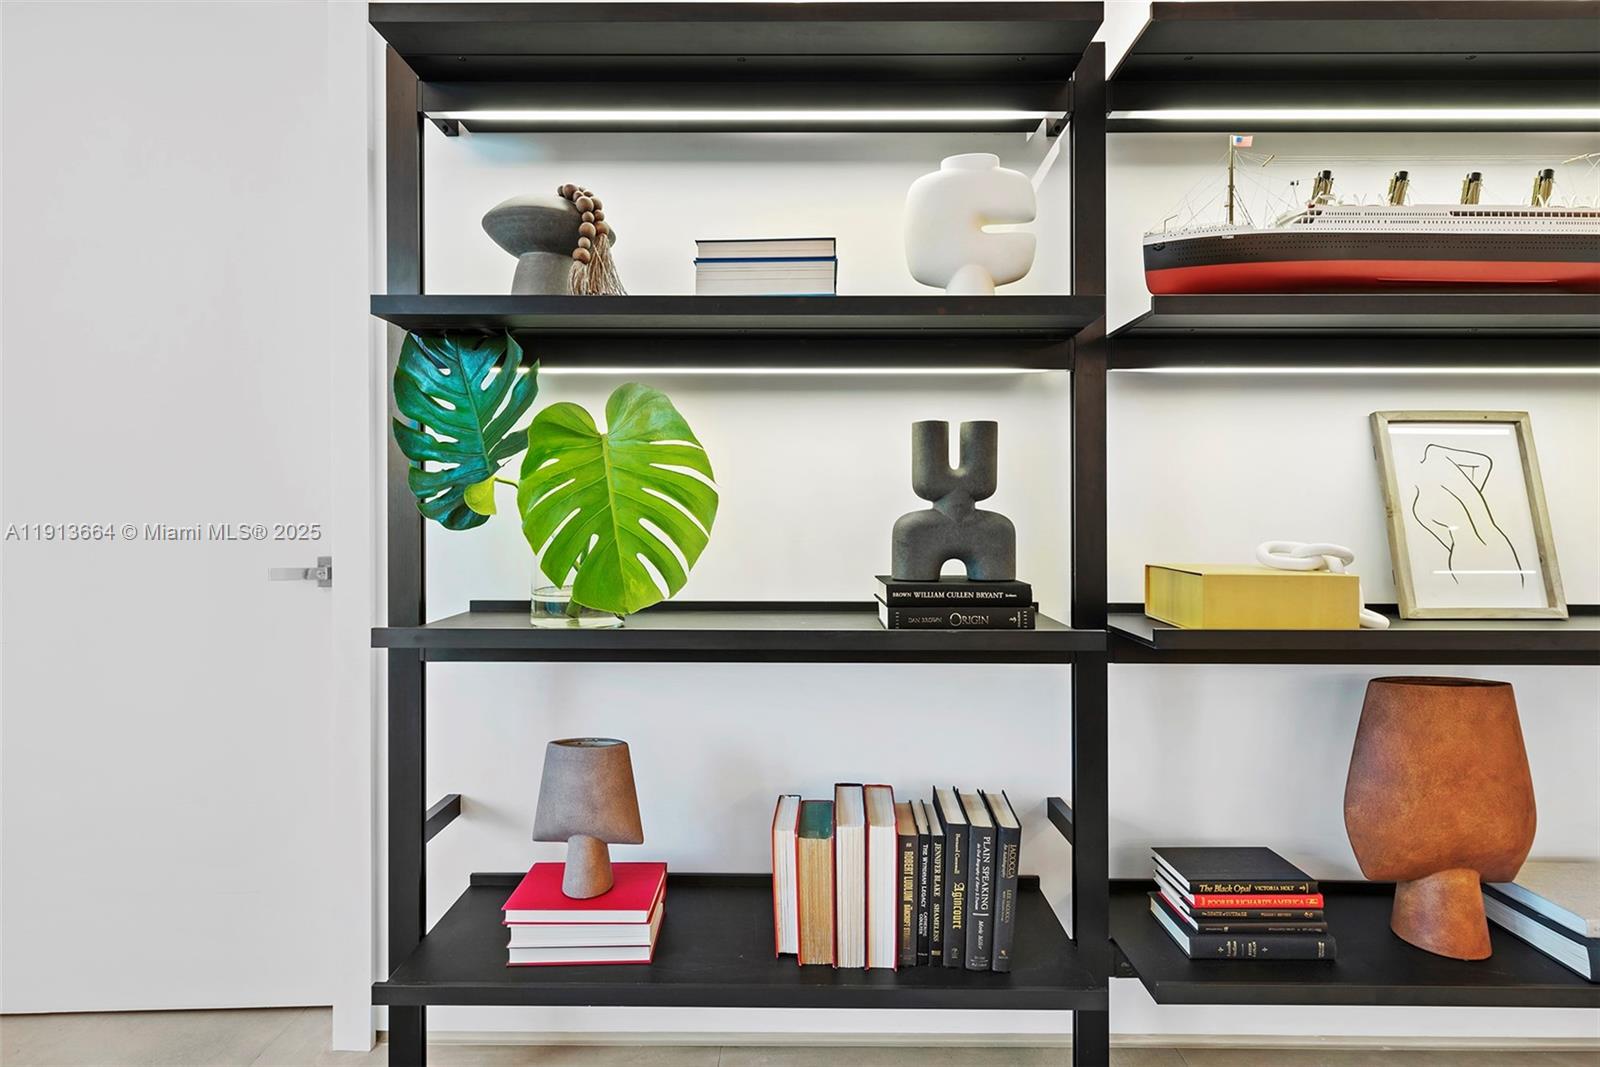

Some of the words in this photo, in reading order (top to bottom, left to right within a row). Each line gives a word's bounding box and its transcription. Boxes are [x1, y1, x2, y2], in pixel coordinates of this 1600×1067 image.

[913, 591, 945, 599] WILLIAM
[946, 591, 974, 599] CULLEN
[975, 591, 1004, 599] BRYANT
[903, 851, 914, 875] ROBERT
[934, 842, 942, 874] JENNIFER
[983, 836, 991, 863] PLAIN
[1007, 844, 1017, 879] IACOCCA
[933, 875, 942, 897] BLAKE
[980, 866, 990, 911] SPEAKING
[1199, 884, 1213, 892] The
[1213, 884, 1232, 892] Black
[1233, 884, 1251, 893] Opal
[952, 882, 965, 930] Agincourt
